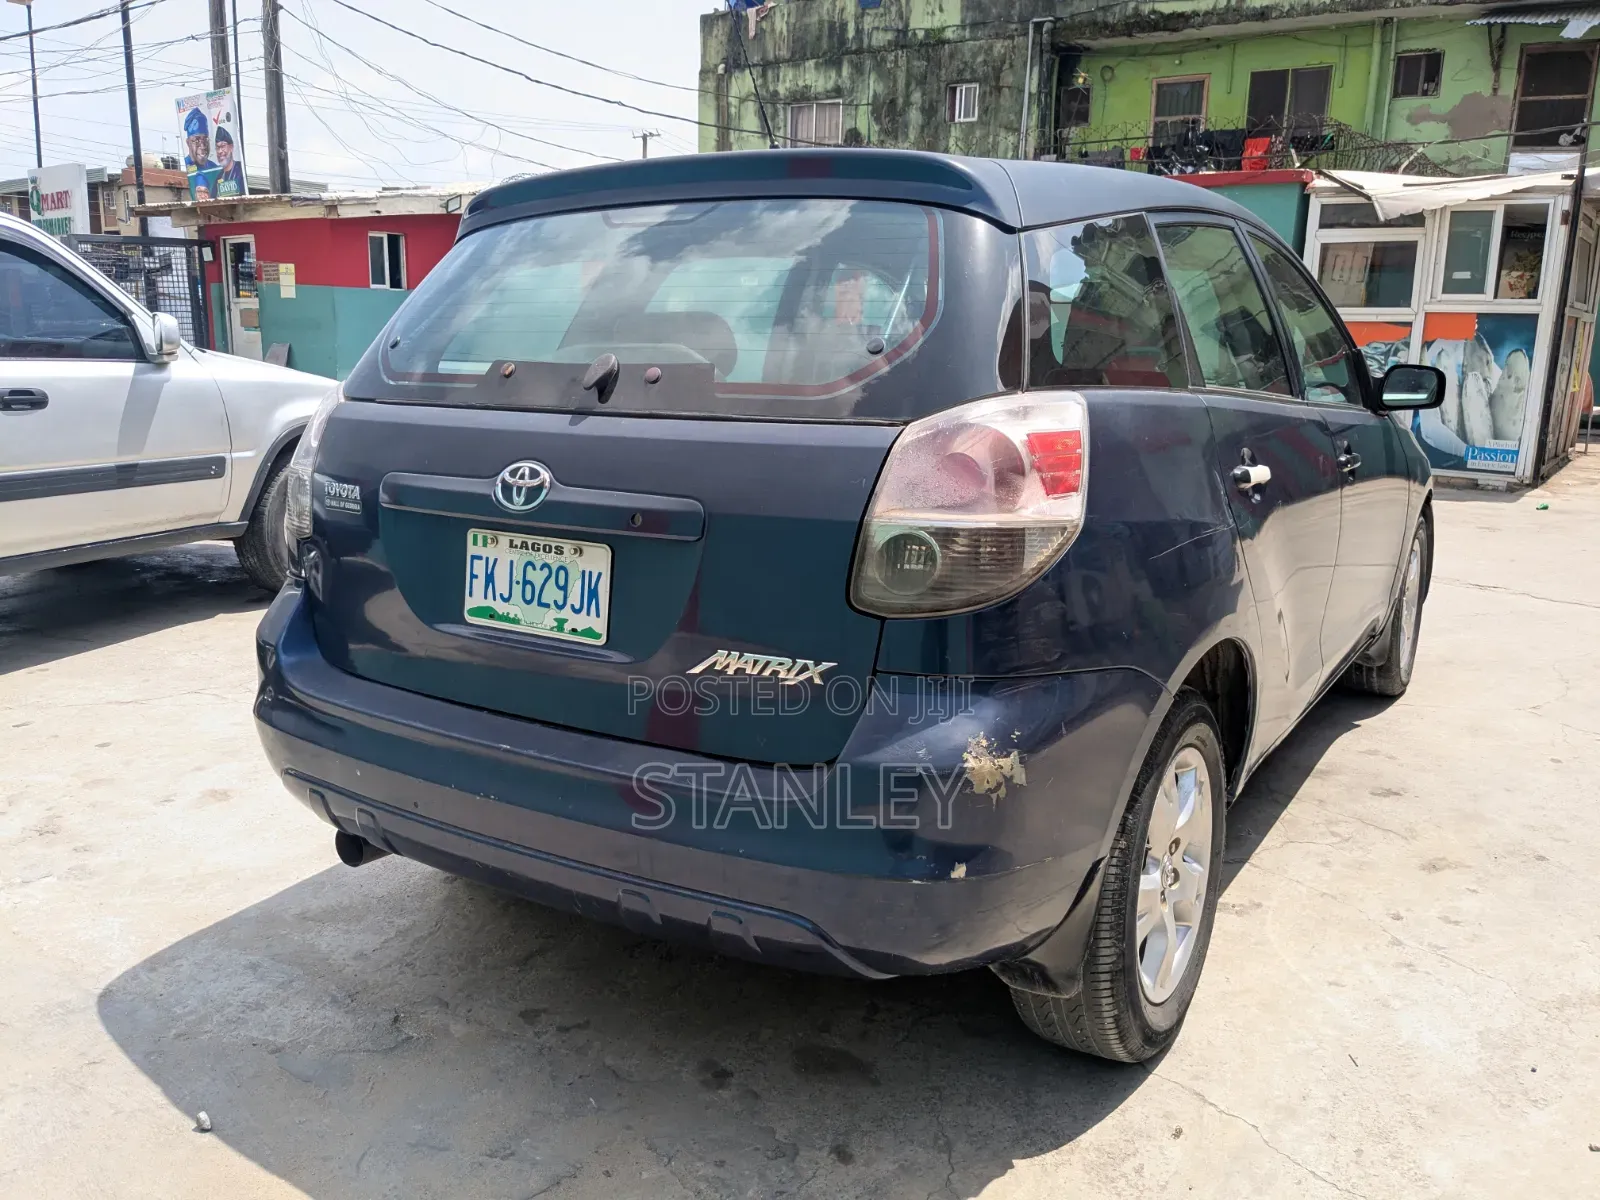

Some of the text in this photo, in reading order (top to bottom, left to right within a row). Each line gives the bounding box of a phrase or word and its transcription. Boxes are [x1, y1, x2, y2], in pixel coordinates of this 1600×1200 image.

[1468, 447, 1517, 463] Passion
[324, 481, 361, 500] TOYOTA
[508, 538, 565, 556] LAGOS
[686, 650, 838, 685] MATRIX
